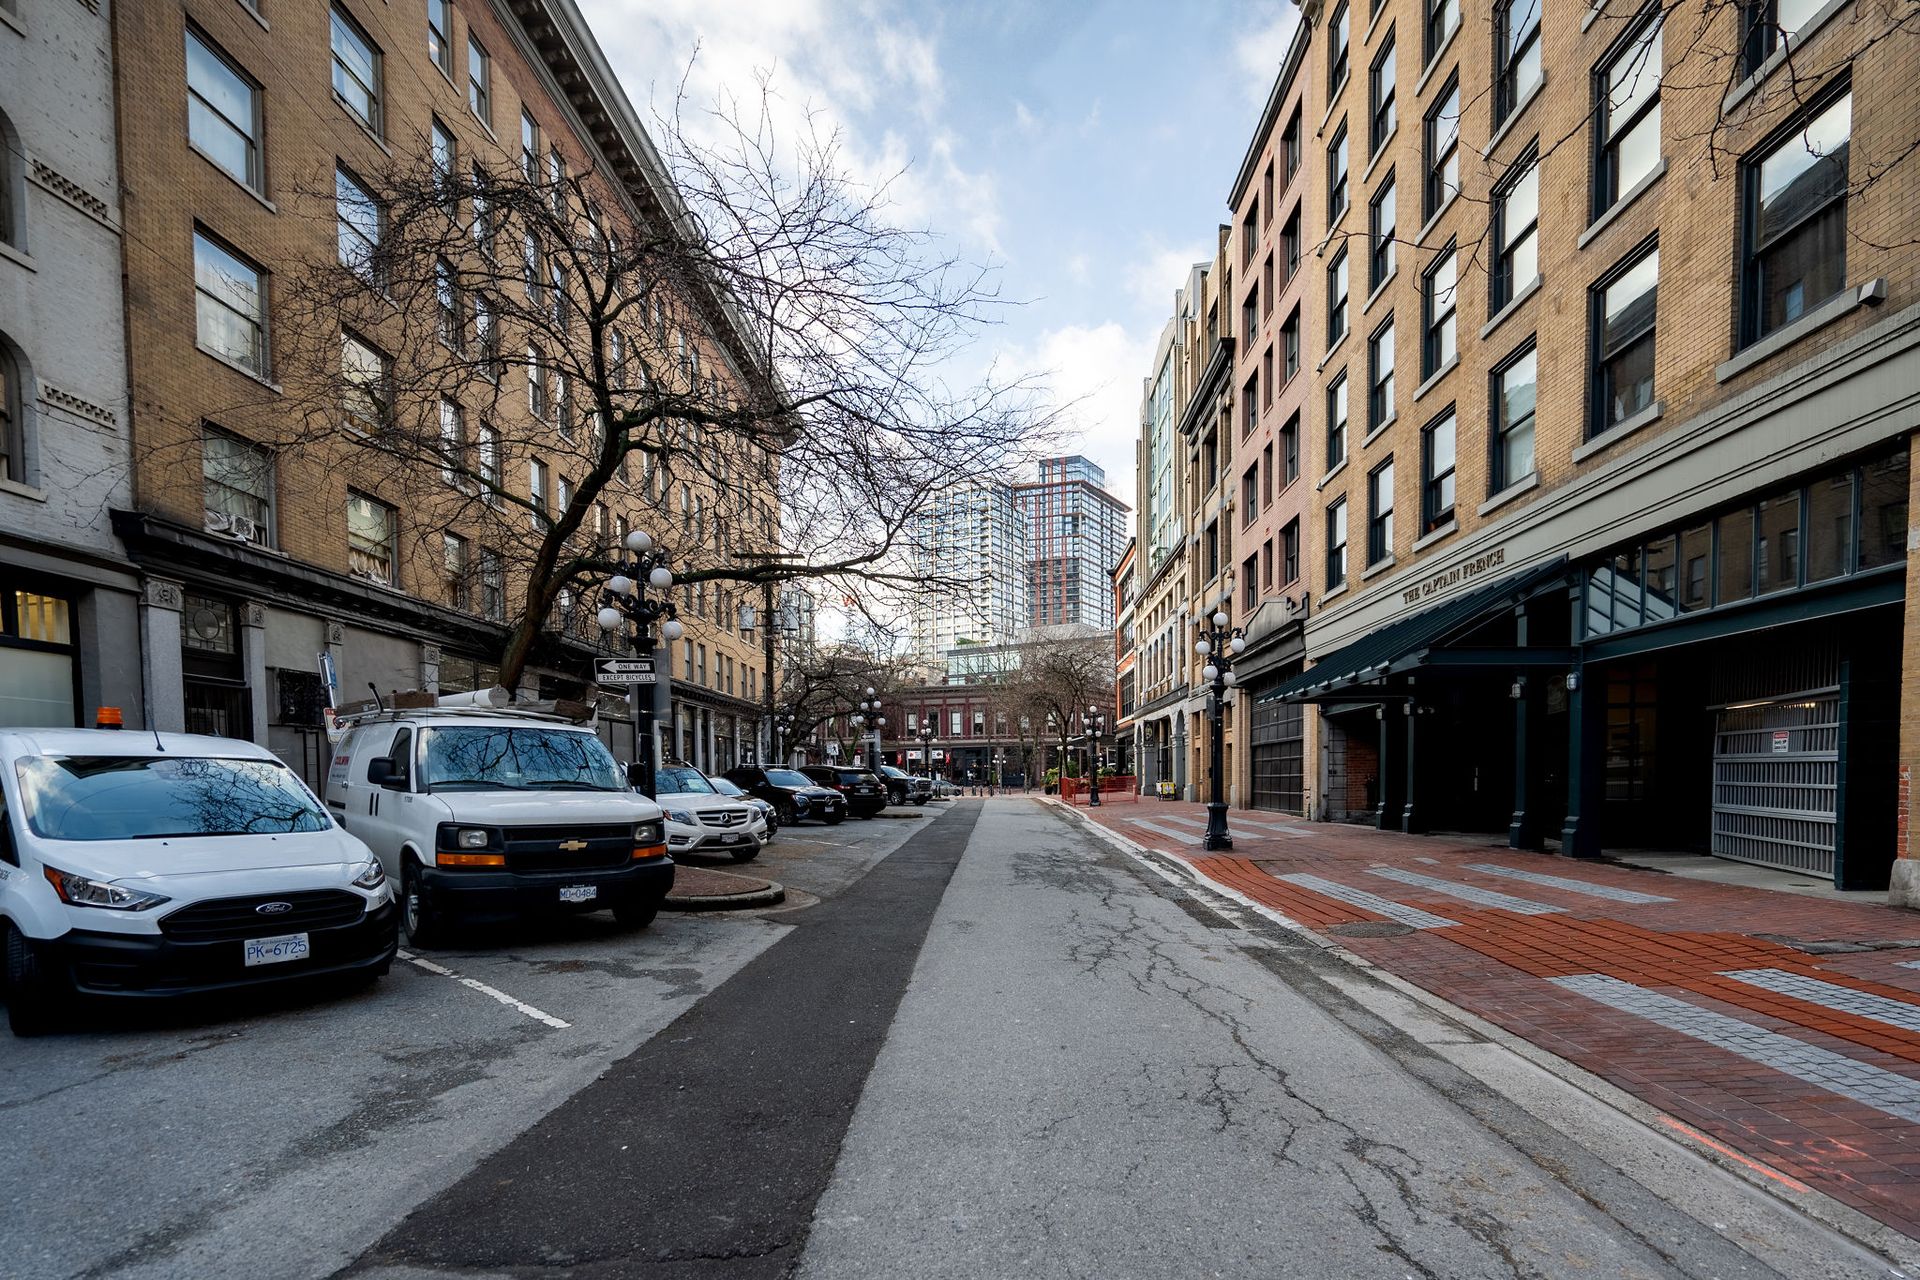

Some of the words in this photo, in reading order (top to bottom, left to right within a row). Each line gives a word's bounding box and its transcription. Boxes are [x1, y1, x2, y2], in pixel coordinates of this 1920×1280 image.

[1402, 586, 1420, 604] THE
[1422, 568, 1460, 596] CAPTAIN
[1462, 548, 1505, 579] FRENCH
[264, 904, 286, 913] Ford
[247, 945, 265, 960] PK
[273, 940, 307, 956] 6725
